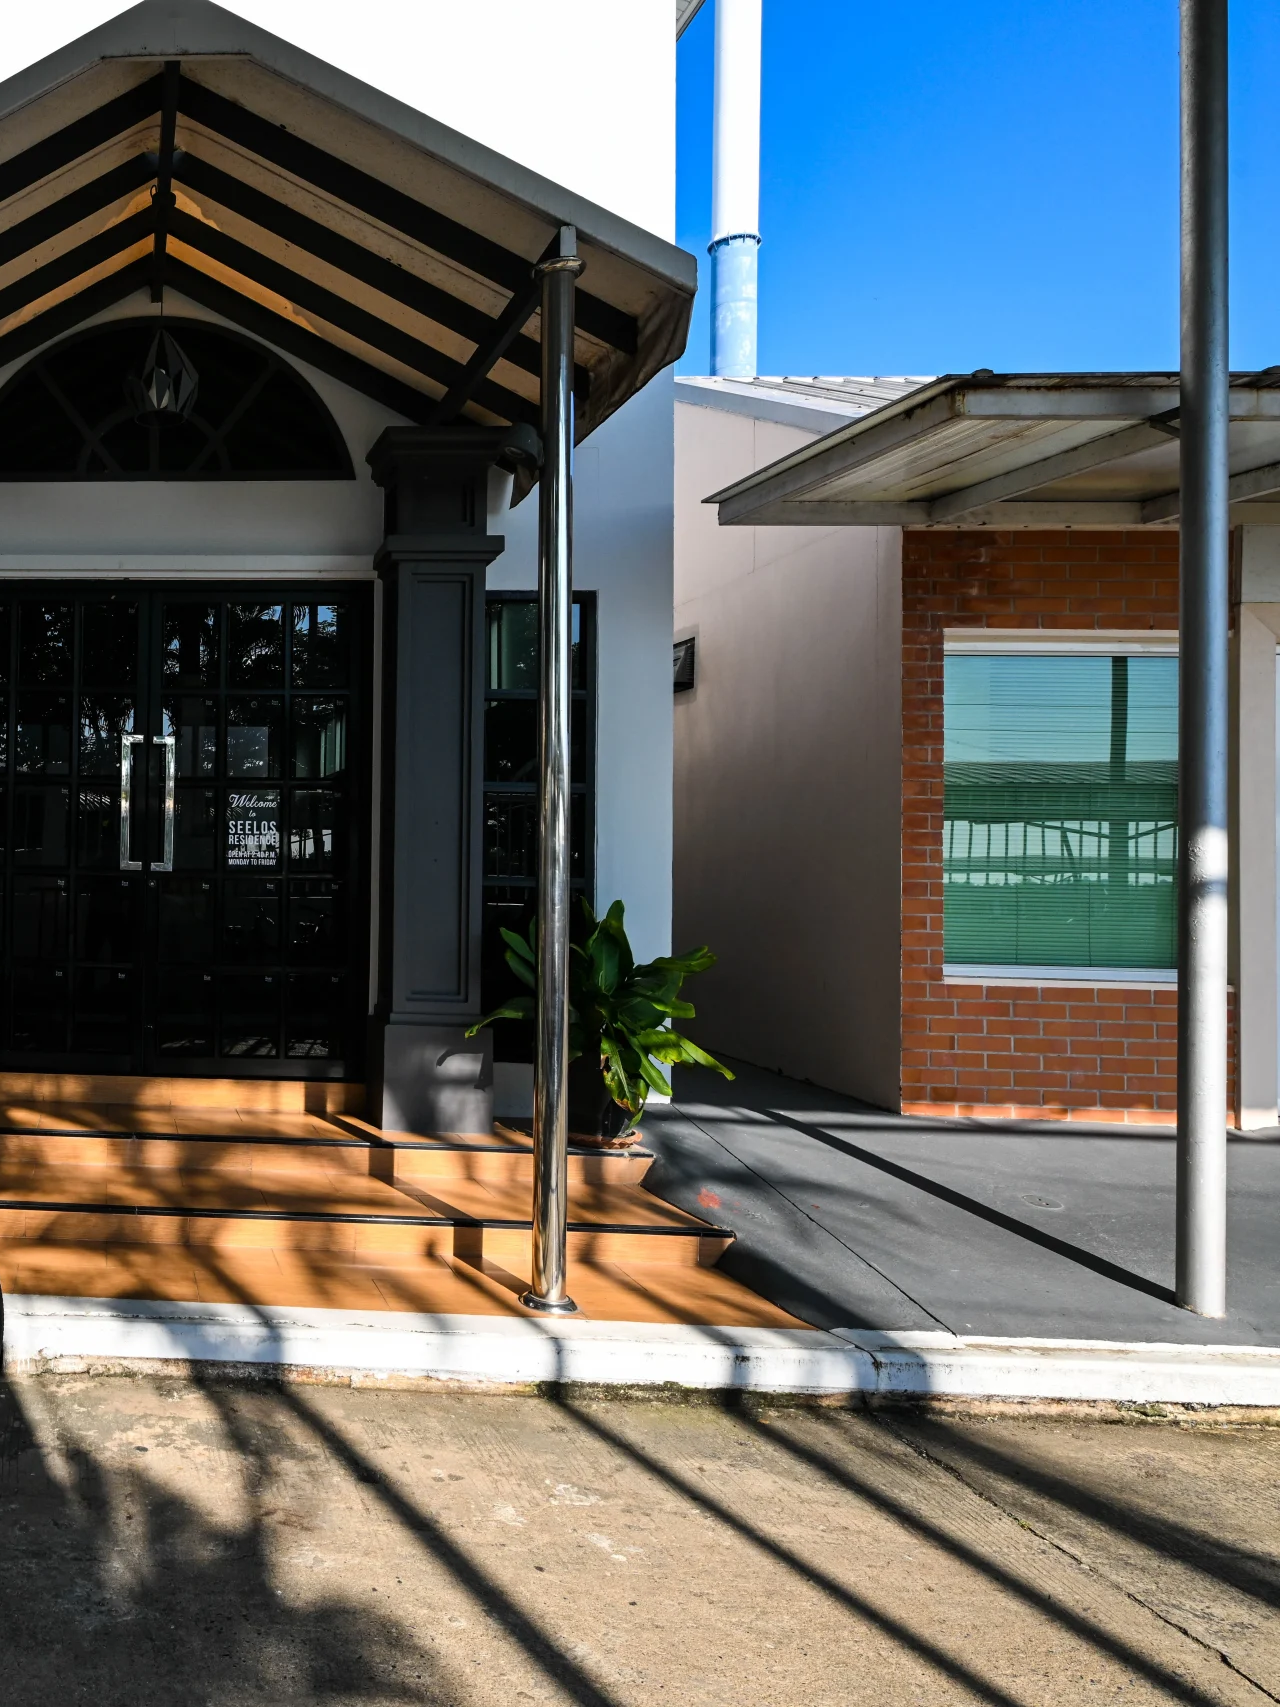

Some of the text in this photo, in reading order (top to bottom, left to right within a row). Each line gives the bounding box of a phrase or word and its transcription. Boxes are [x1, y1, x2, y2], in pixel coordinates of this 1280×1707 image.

[228, 794, 278, 808] Welcome
[228, 820, 277, 834] SEELOS
[228, 834, 277, 845] RESIDENCE
[228, 858, 277, 866] MONDAY TO FRIDAY
